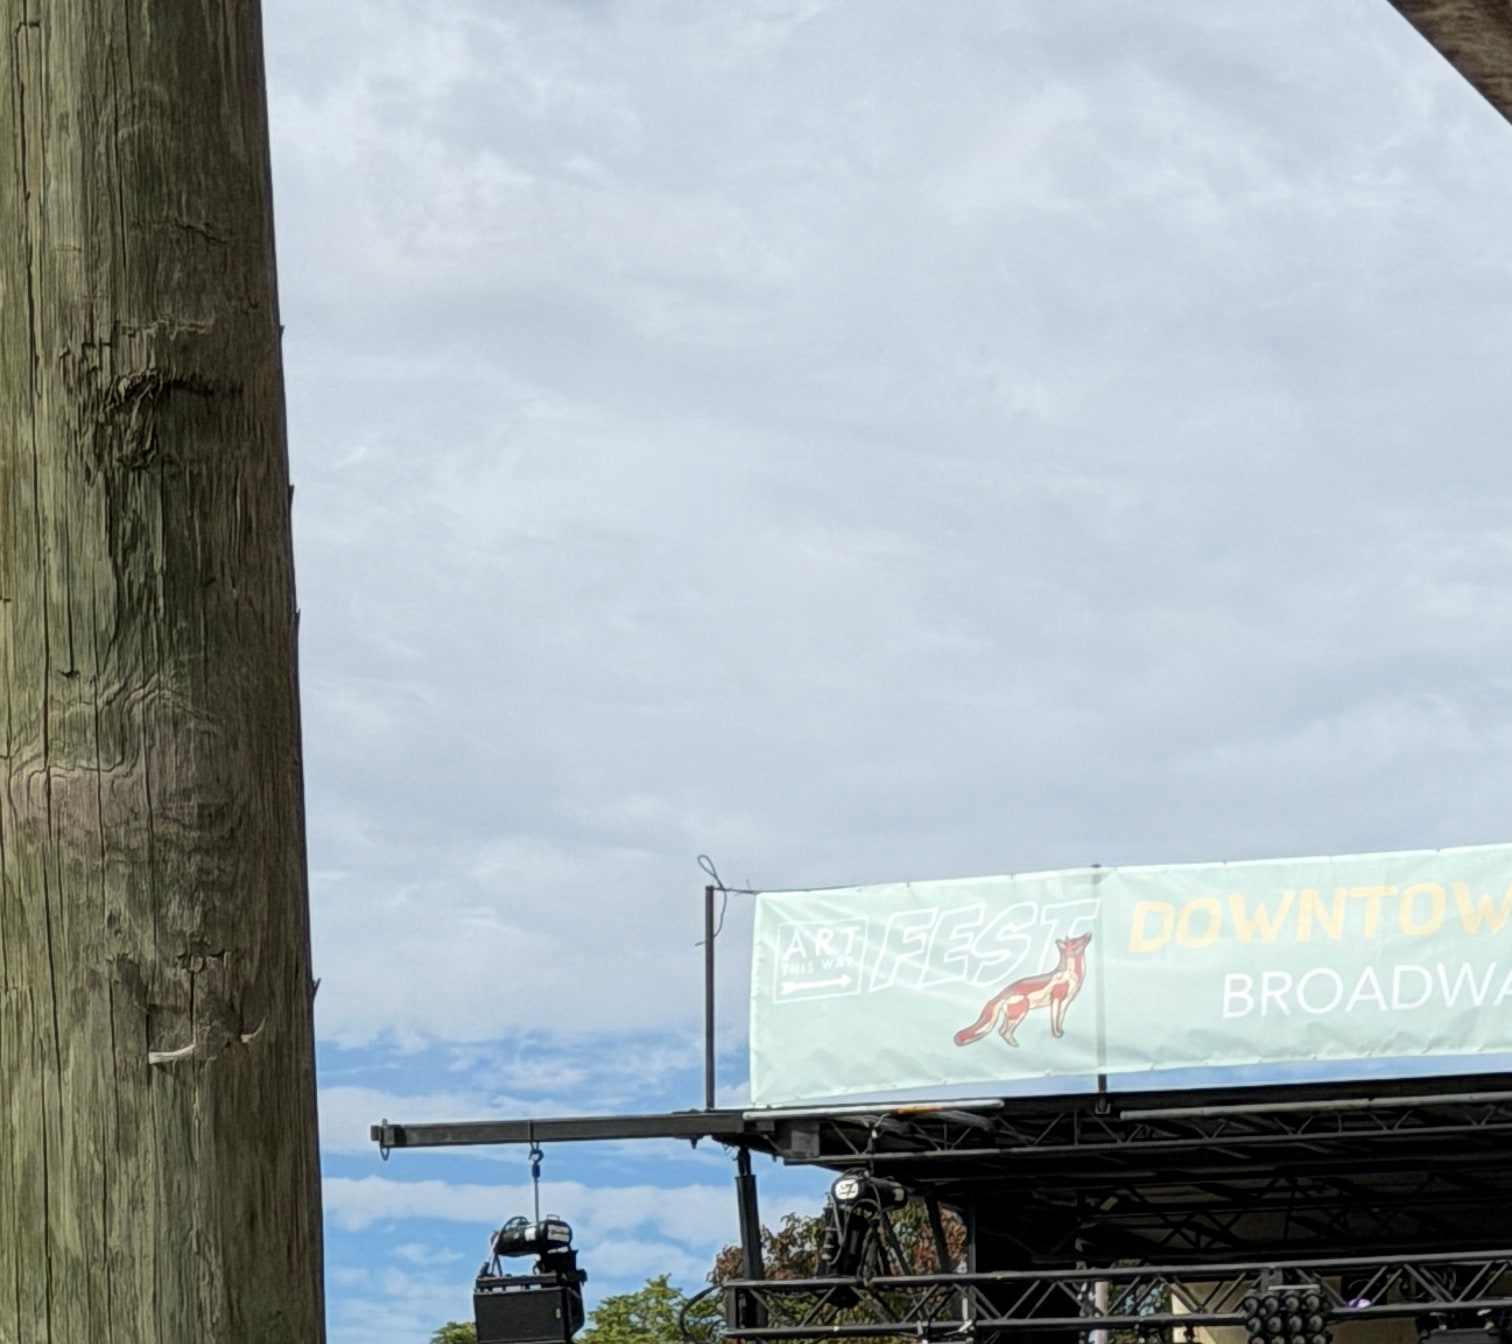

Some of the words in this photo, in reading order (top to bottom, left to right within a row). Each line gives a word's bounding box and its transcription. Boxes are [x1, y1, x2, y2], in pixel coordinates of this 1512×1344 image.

[782, 926, 861, 961] ART
[868, 899, 1100, 994] FEST
[782, 961, 814, 977] THIS
